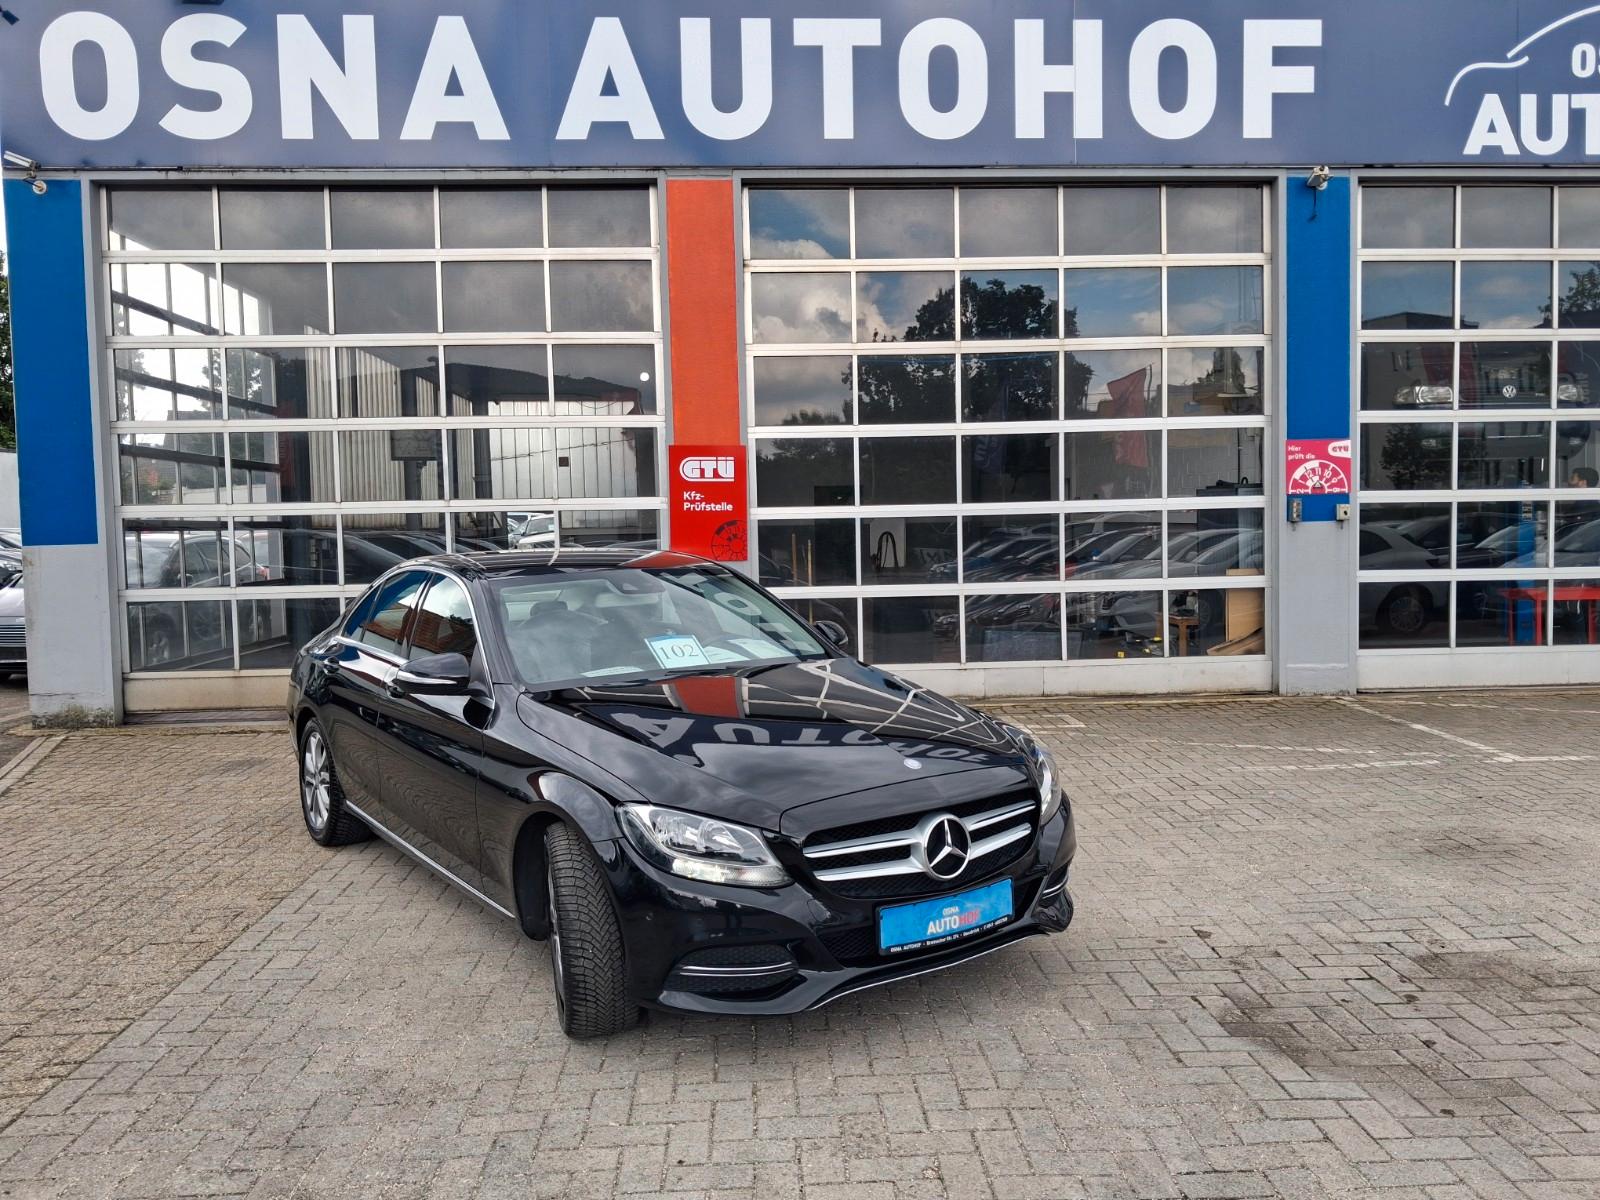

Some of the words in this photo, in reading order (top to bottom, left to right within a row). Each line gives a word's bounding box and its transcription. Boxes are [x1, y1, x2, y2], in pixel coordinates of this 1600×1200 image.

[1571, 42, 1600, 78] O
[39, 12, 510, 141] OSNA
[555, 17, 1322, 141] AUTOHOF
[1288, 453, 1305, 461] prüft
[680, 457, 735, 481] GTÜ
[683, 491, 705, 500] Kfz-
[683, 502, 733, 511] Prüfstelle
[660, 644, 699, 660] 102
